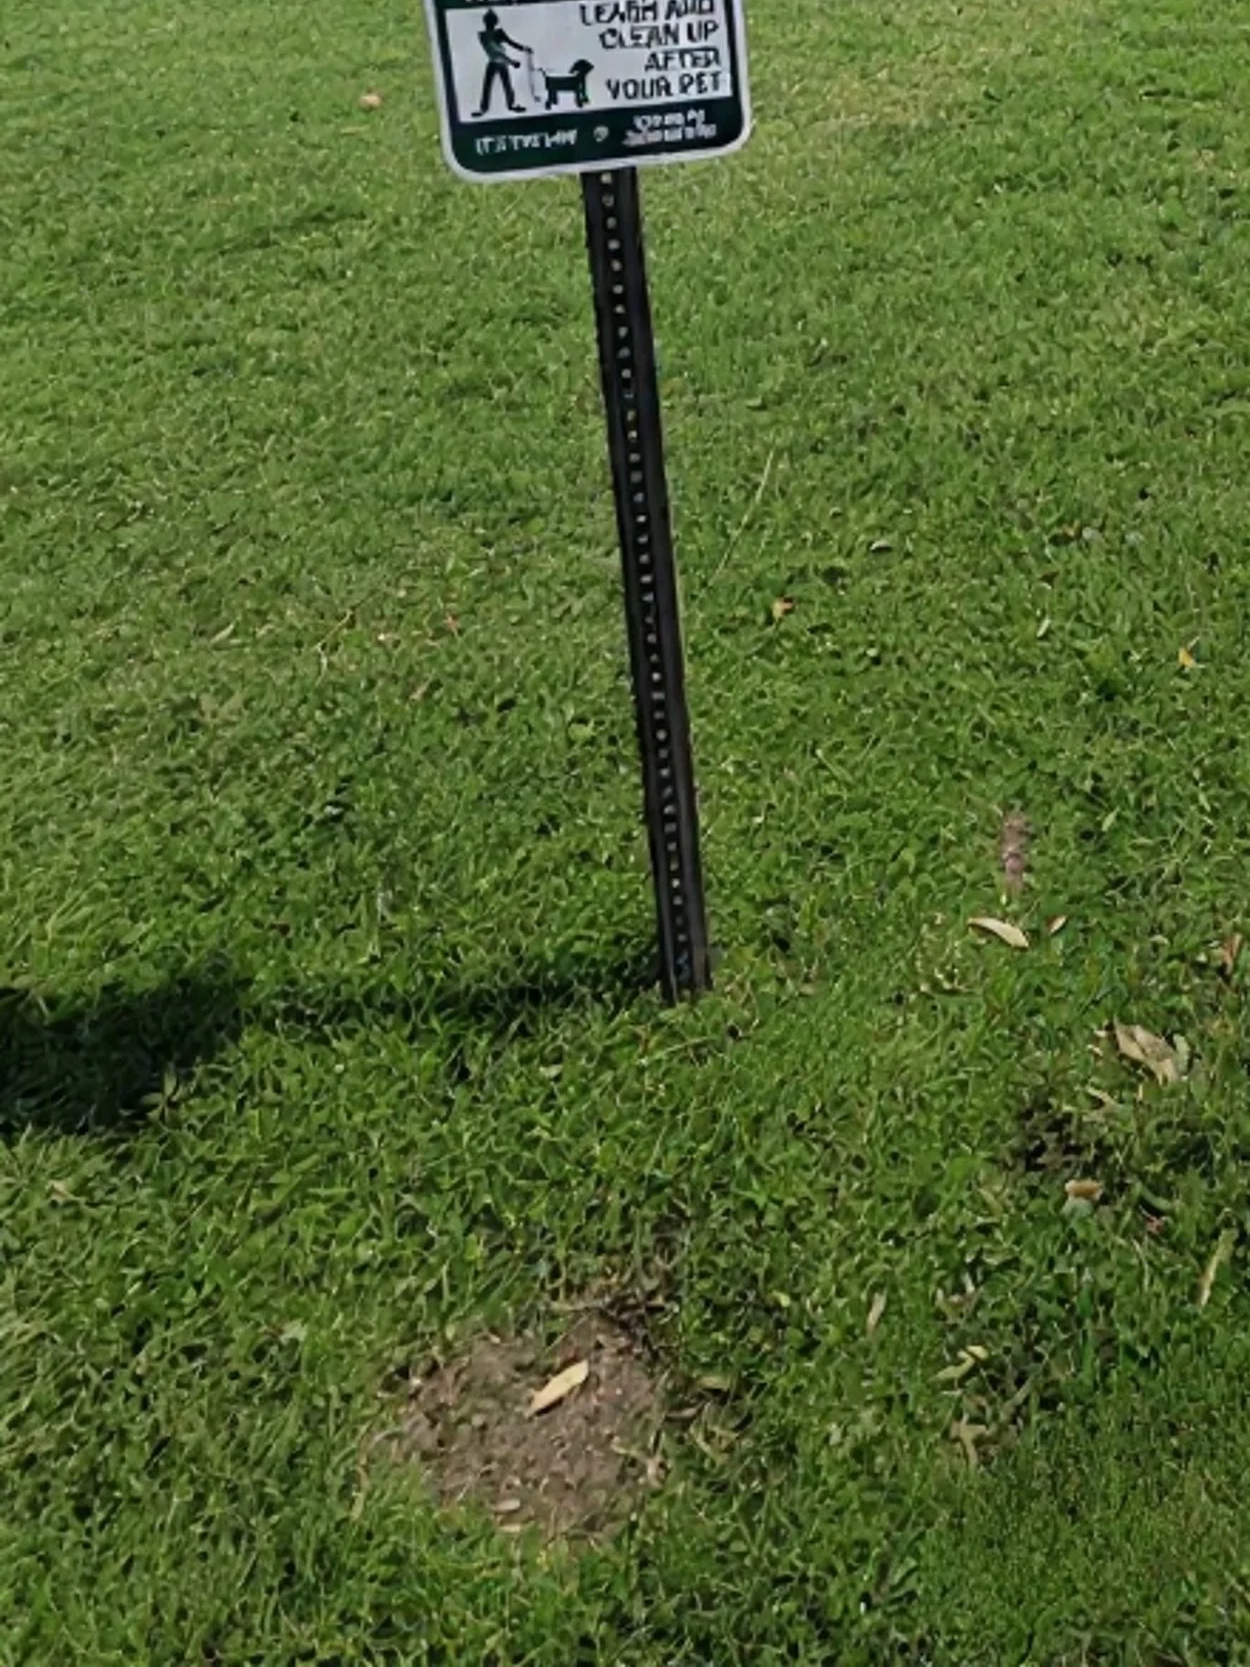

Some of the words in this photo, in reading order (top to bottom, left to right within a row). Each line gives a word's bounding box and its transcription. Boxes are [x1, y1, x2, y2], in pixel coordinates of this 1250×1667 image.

[599, 22, 680, 49] CLEAN
[687, 20, 719, 43] UP
[644, 47, 721, 72] AFTER
[606, 76, 673, 100] YOUR
[678, 71, 722, 95] PET
